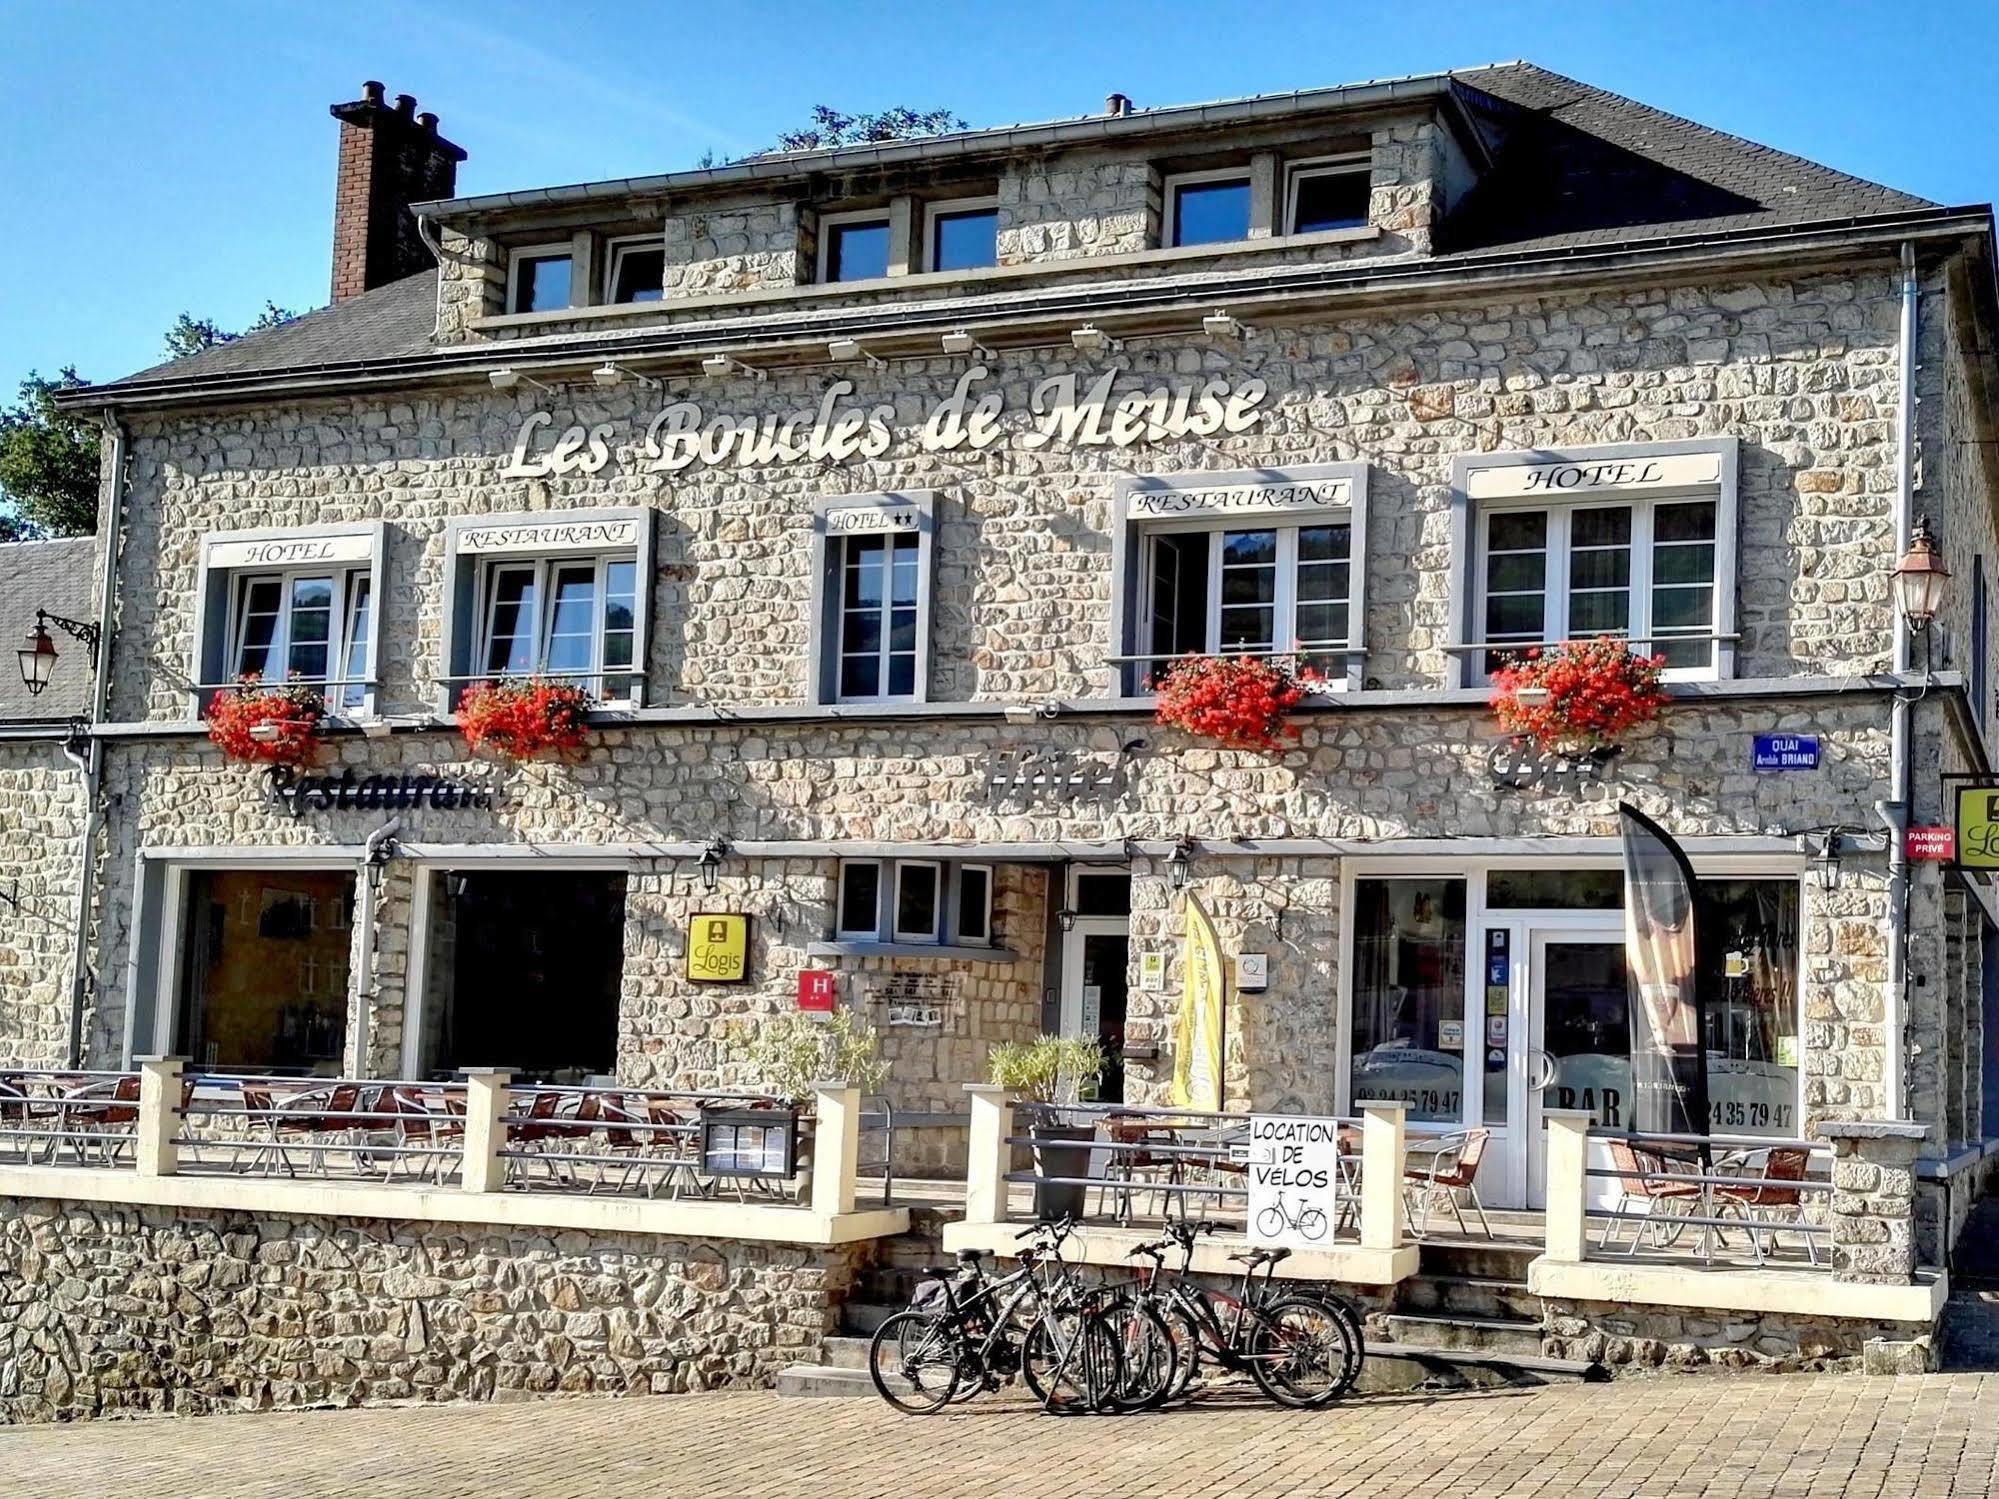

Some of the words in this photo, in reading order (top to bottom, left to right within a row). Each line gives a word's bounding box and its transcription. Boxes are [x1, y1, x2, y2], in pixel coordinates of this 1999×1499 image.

[500, 411, 614, 478] Les
[645, 380, 896, 473] Boucles
[923, 366, 1005, 450] de
[1023, 366, 1267, 449] Meuse
[1523, 463, 1663, 490] HOTEL
[1137, 483, 1345, 514] RESTAURANT
[832, 512, 889, 530] HOTEL
[464, 523, 631, 548] RESTAURANT
[244, 542, 335, 563] HOTEL
[1772, 740, 1799, 752] QUAI
[1781, 753, 1814, 765] BRIAND
[262, 763, 504, 817] Restaurant
[1908, 832, 1952, 841] PARKING
[692, 943, 741, 976] Logis
[813, 978, 828, 993] H
[1421, 1089, 1438, 1112] 79
[1442, 1090, 1459, 1113] 47
[1726, 1102, 1745, 1126] 35
[1750, 1102, 1769, 1127] 79
[1774, 1103, 1792, 1128] 47
[1253, 1121, 1334, 1143] LOCATION
[1282, 1145, 1304, 1164] DE
[1256, 1167, 1328, 1188] VÉLOS
